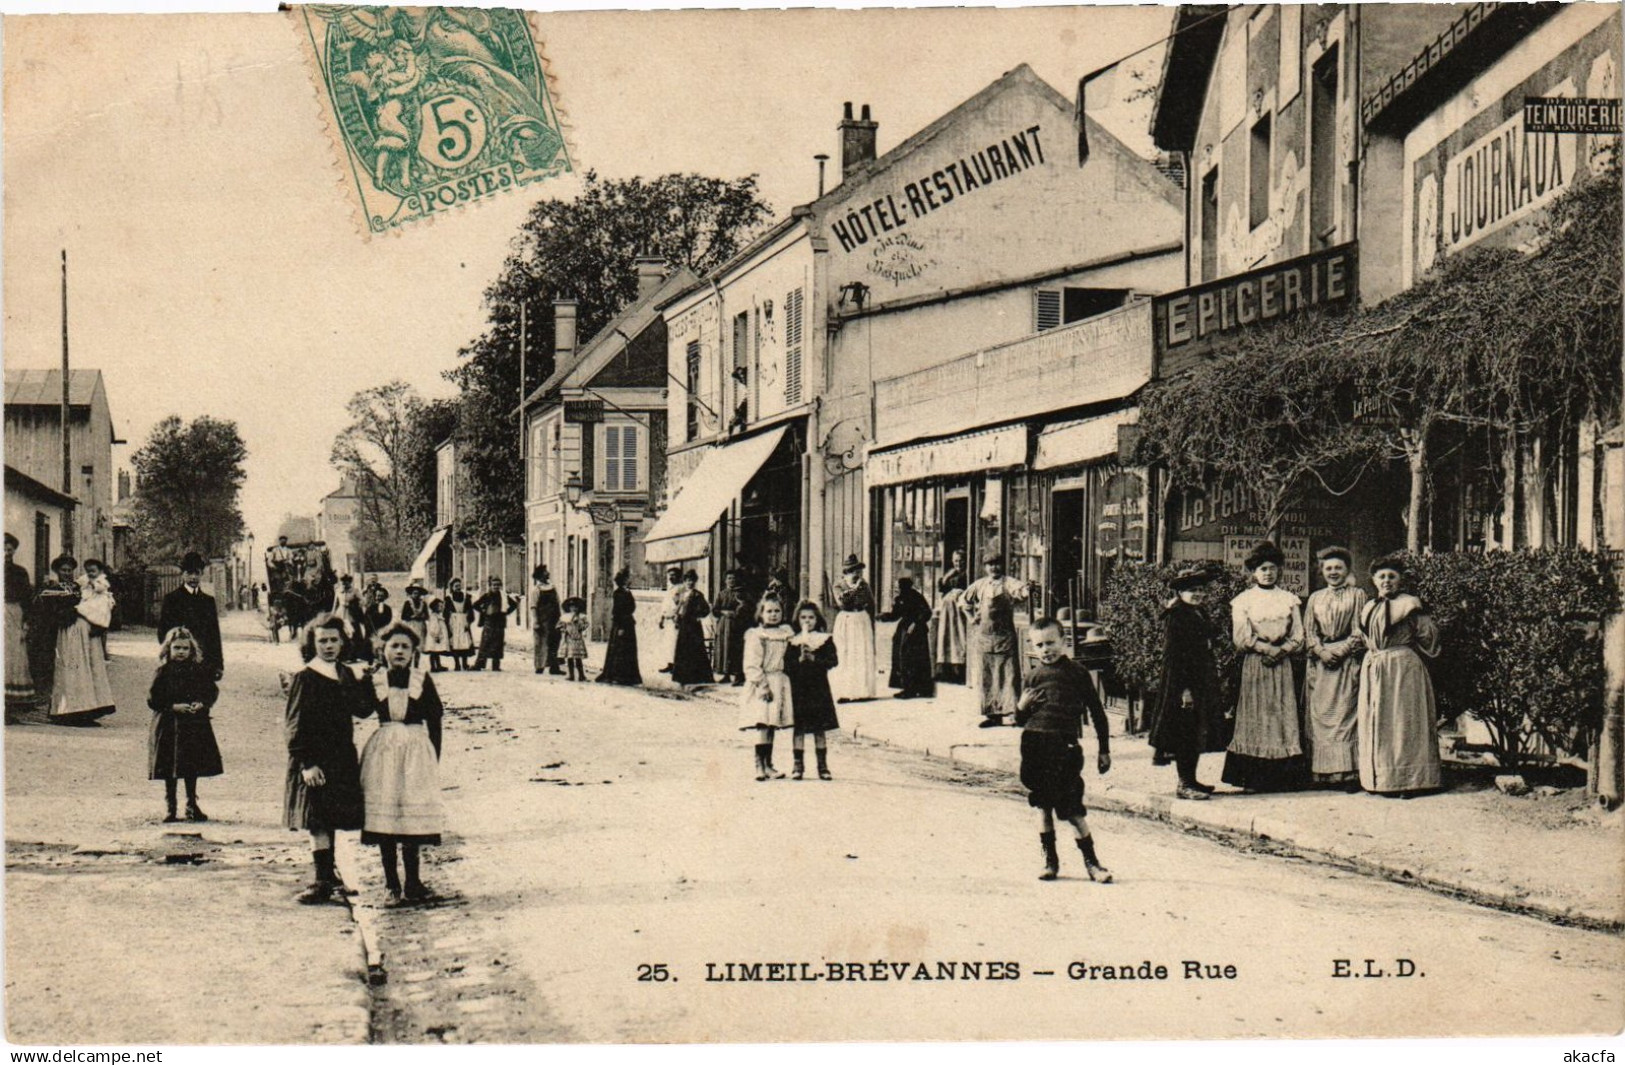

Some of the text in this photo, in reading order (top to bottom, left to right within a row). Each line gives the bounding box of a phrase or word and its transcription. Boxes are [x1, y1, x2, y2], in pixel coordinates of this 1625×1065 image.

[422, 167, 511, 212] POSTES
[1168, 256, 1345, 346] EPICERIE
[1181, 489, 1204, 531] Le
